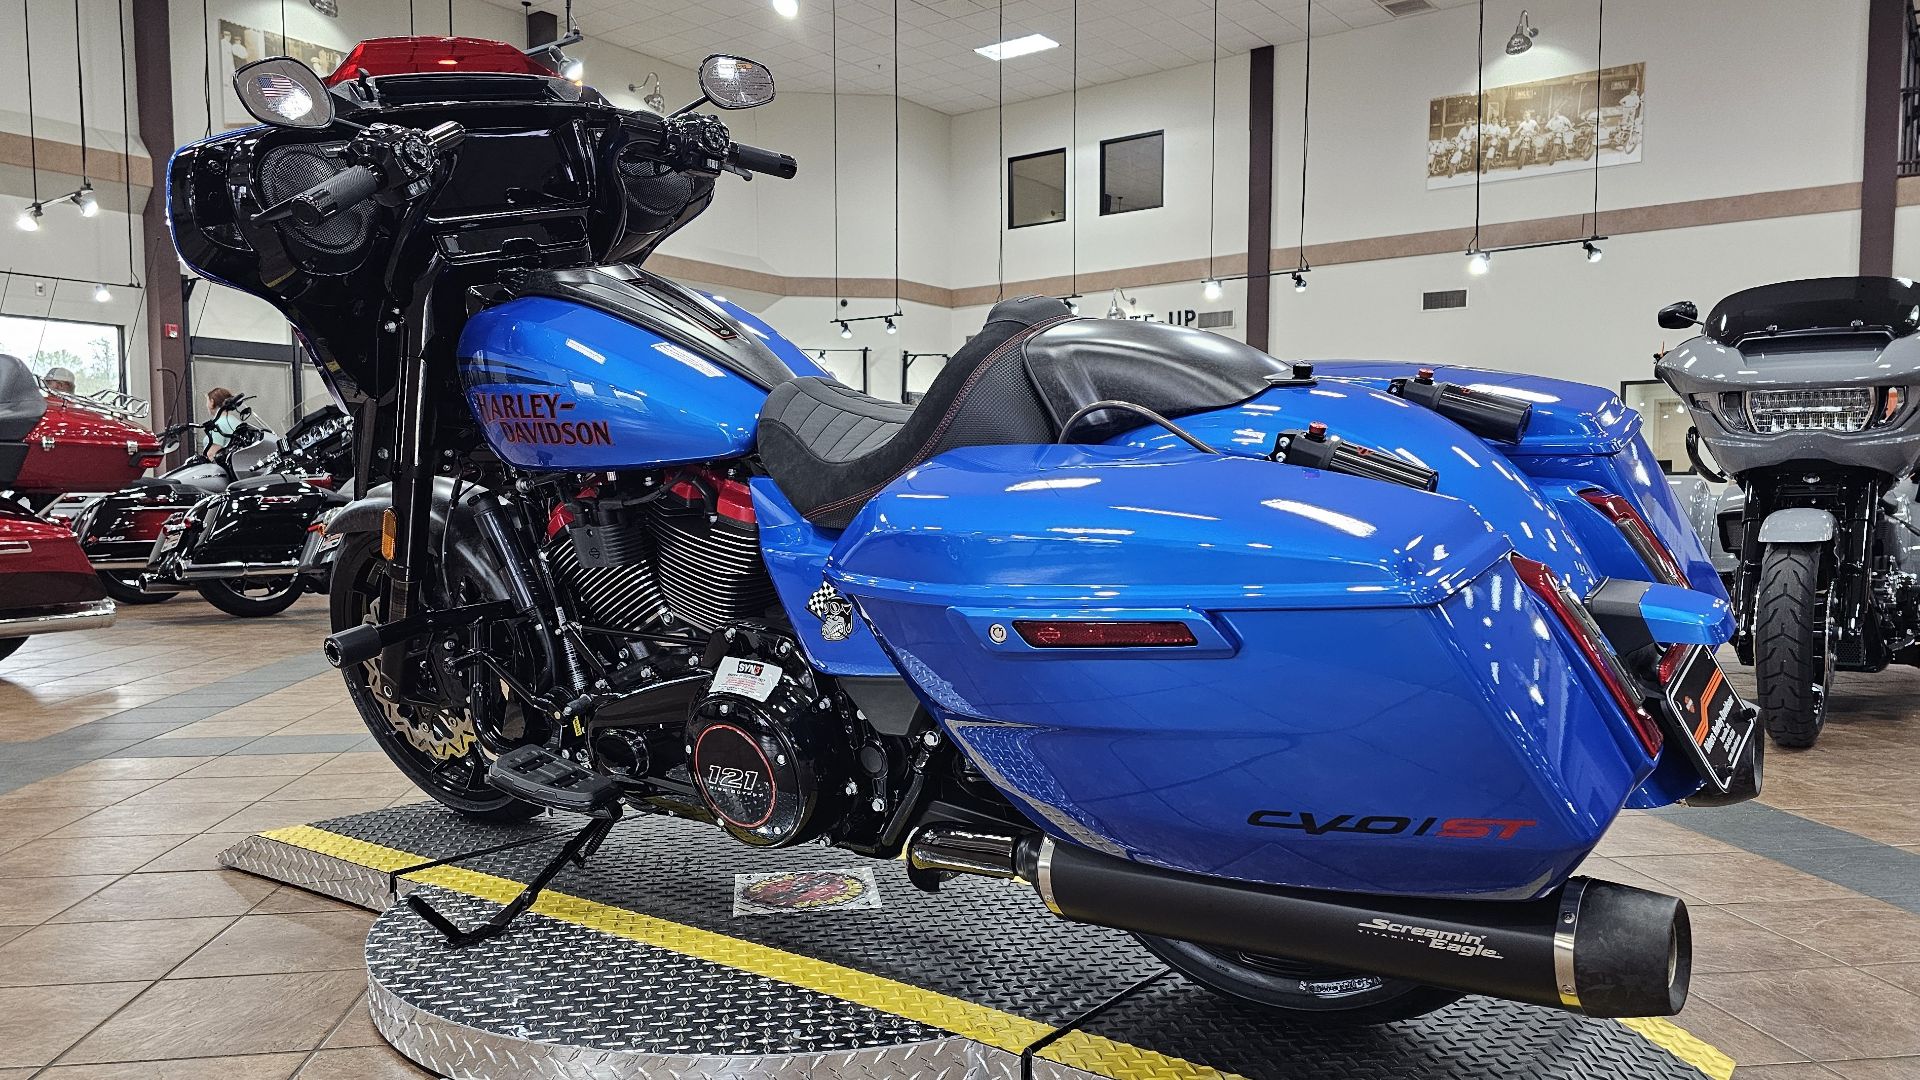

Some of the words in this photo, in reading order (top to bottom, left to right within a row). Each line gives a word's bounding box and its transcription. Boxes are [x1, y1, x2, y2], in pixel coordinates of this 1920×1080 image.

[477, 393, 576, 422] HARLEY-
[499, 420, 613, 446] DAVIDSON
[708, 764, 758, 791] 121
